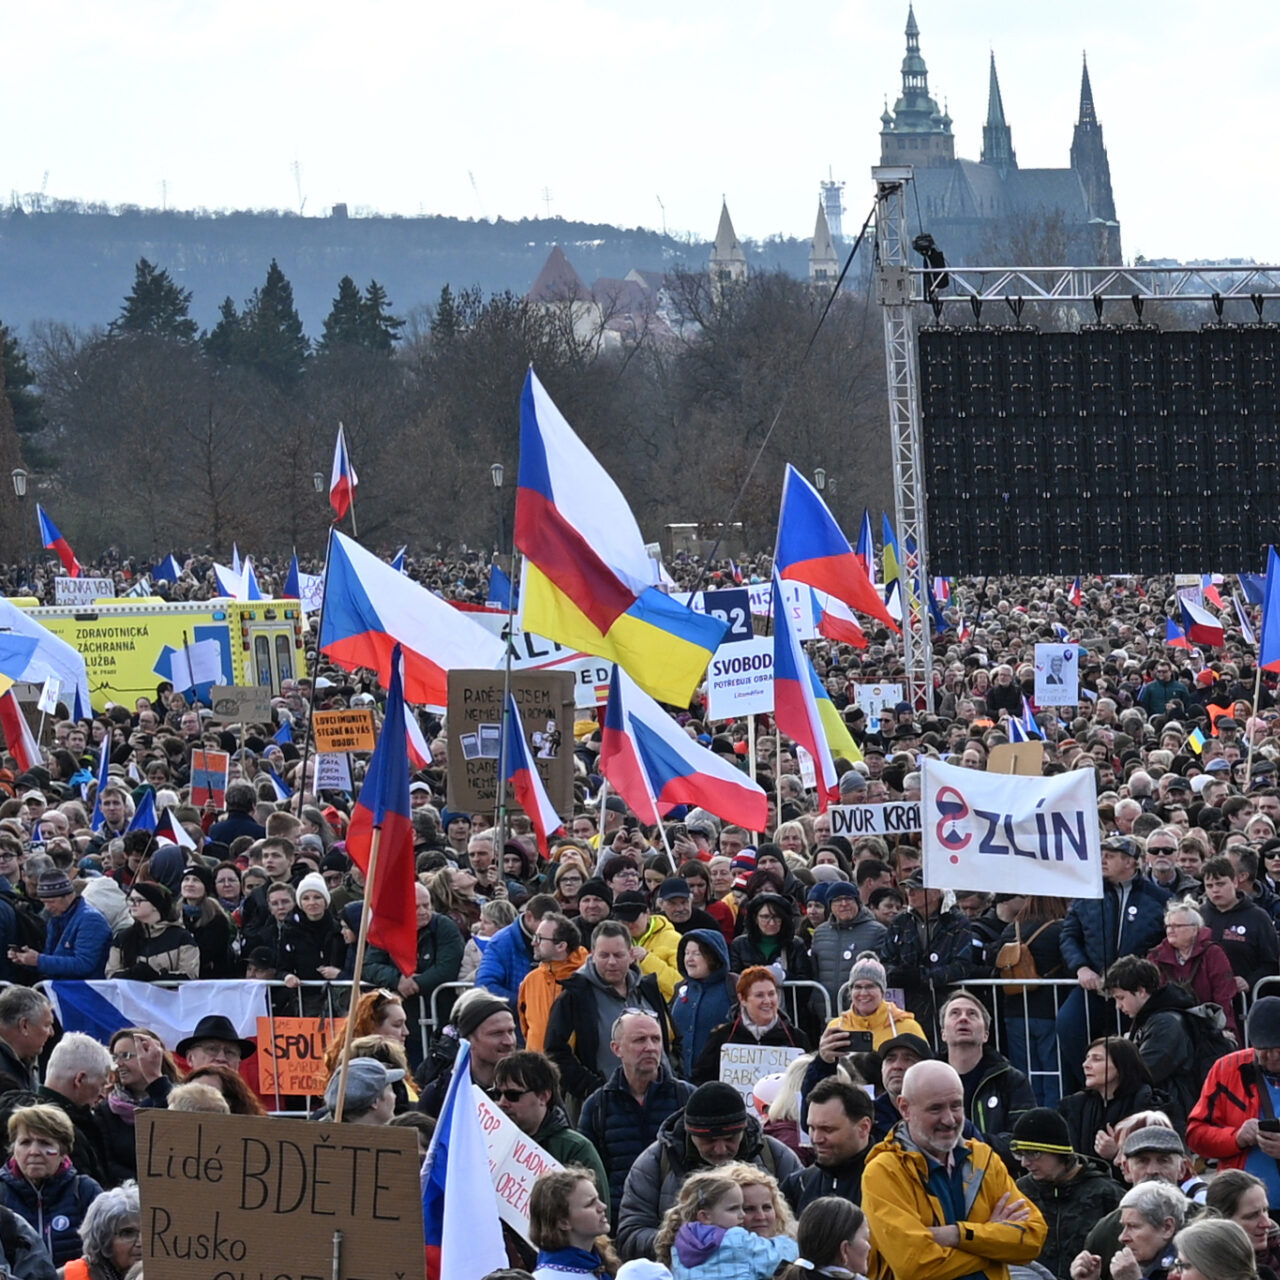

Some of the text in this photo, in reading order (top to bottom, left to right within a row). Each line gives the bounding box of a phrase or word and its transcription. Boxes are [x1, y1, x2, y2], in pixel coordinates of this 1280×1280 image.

[76, 625, 149, 640] ZDRAVOTNICKÁ
[77, 640, 136, 653] ZÁCHRANNÁ
[84, 656, 116, 668] LUŽBA
[713, 653, 774, 677] SVOBOD
[753, 674, 773, 685] OBRA
[517, 689, 550, 704] JSEM
[832, 807, 876, 834] DVŮR
[973, 798, 1088, 861] ZLÍN
[721, 1047, 767, 1064] AGENT
[478, 1102, 501, 1135] STOP
[512, 1139, 557, 1176] VLÁDN
[147, 1121, 402, 1221] Lidé BDĚTE
[149, 1206, 247, 1262] Rusko
